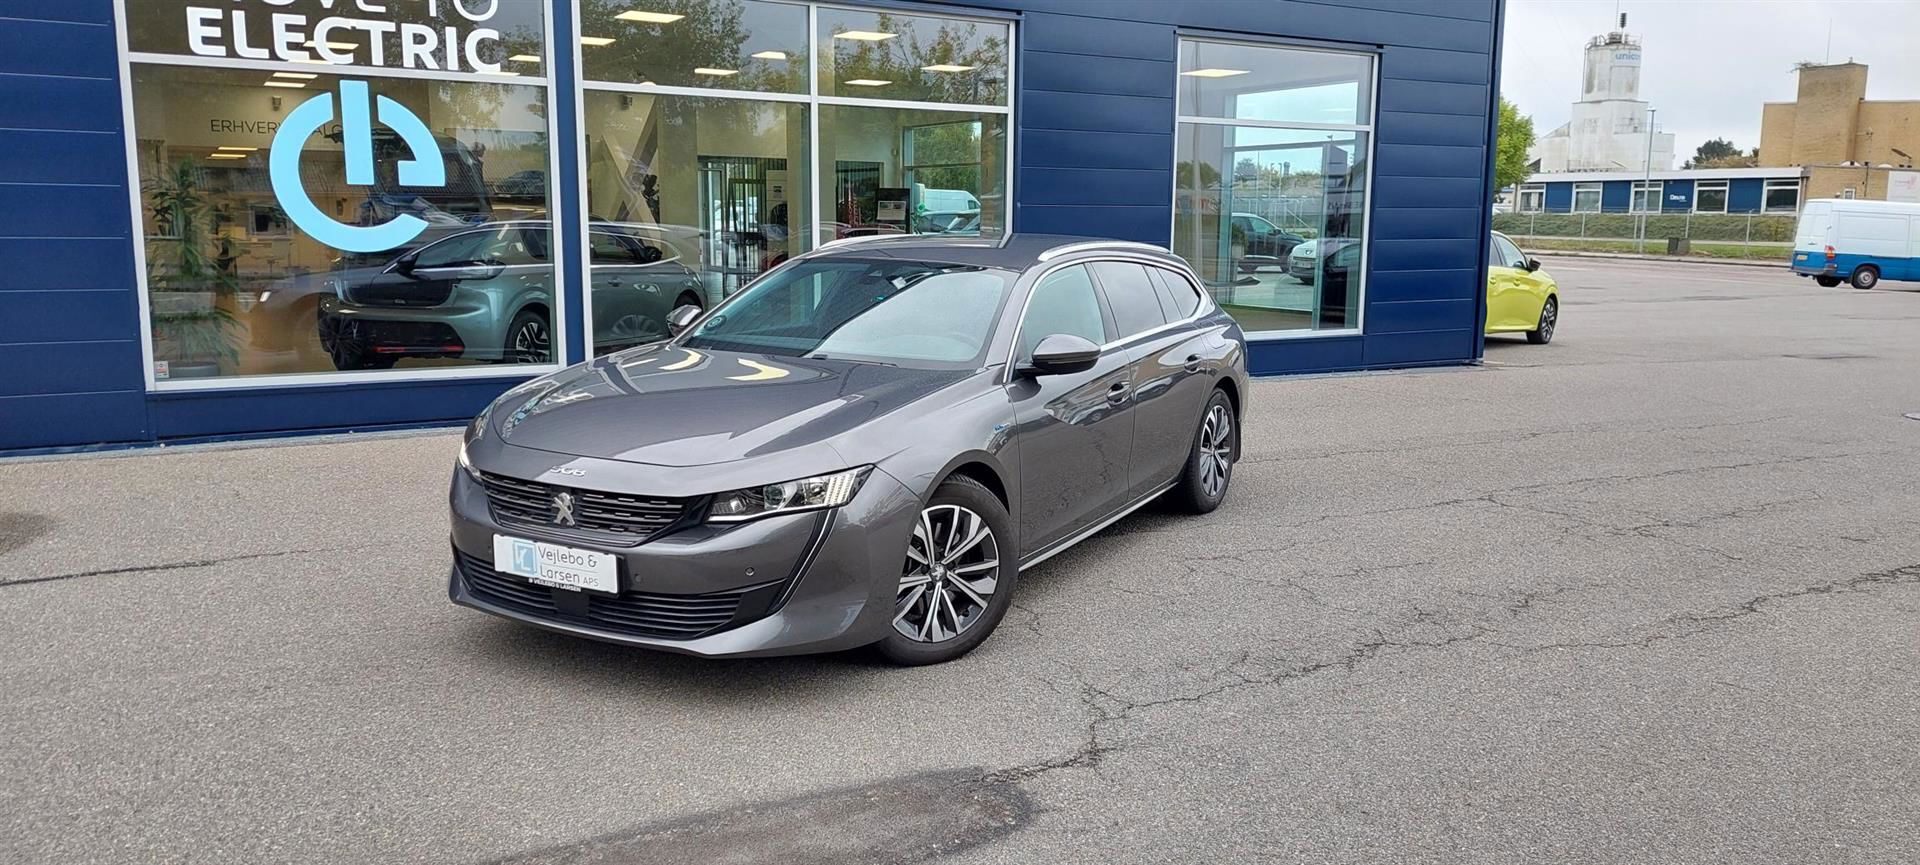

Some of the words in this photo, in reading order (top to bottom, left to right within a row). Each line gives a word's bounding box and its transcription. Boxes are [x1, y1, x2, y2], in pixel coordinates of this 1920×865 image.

[186, 6, 501, 73] ELECTRIC
[538, 546, 584, 566] Vejlebo
[587, 554, 598, 568] &
[540, 565, 580, 583] Larsen
[583, 576, 599, 587] APS
